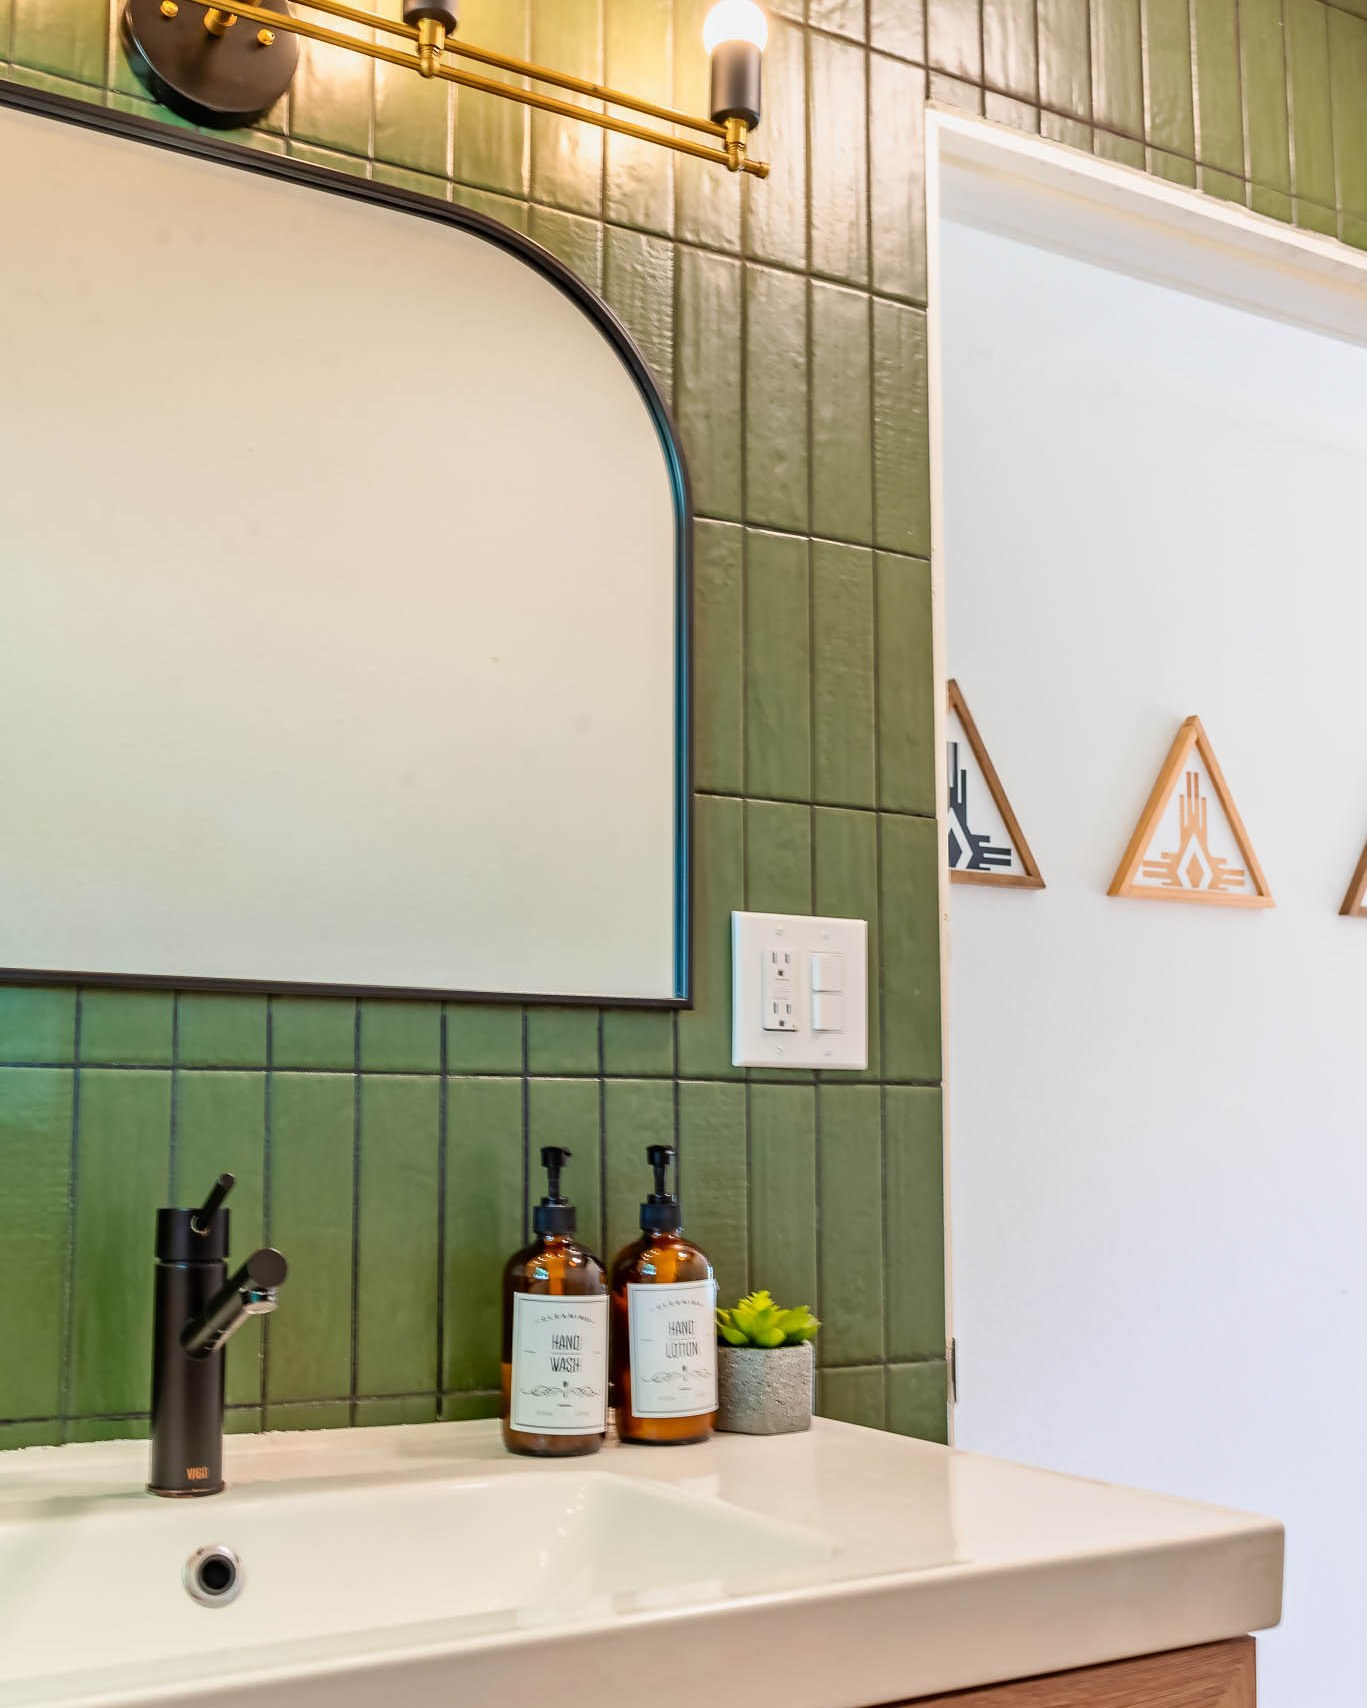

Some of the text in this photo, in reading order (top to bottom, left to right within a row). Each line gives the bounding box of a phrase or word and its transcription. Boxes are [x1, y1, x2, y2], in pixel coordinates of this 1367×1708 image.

[668, 1320, 695, 1337] HAND
[551, 1334, 582, 1351] HAND
[665, 1341, 698, 1359] LOTION
[550, 1356, 582, 1373] WASH
